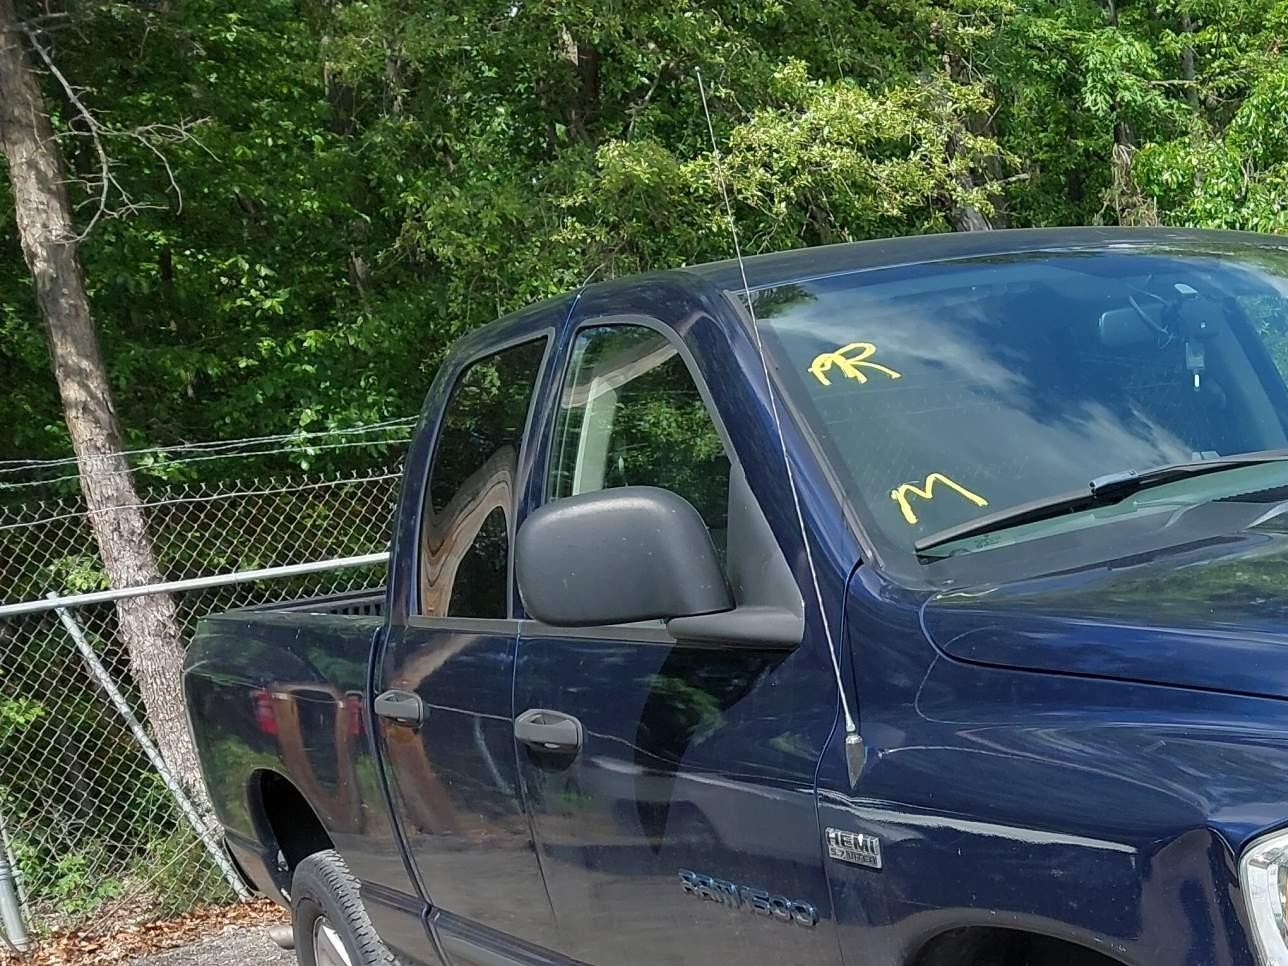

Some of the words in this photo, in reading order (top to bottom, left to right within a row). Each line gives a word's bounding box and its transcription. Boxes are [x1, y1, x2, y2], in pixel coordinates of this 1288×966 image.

[890, 472, 989, 524] M
[826, 829, 879, 856] HEMI
[846, 850, 878, 866] LITER
